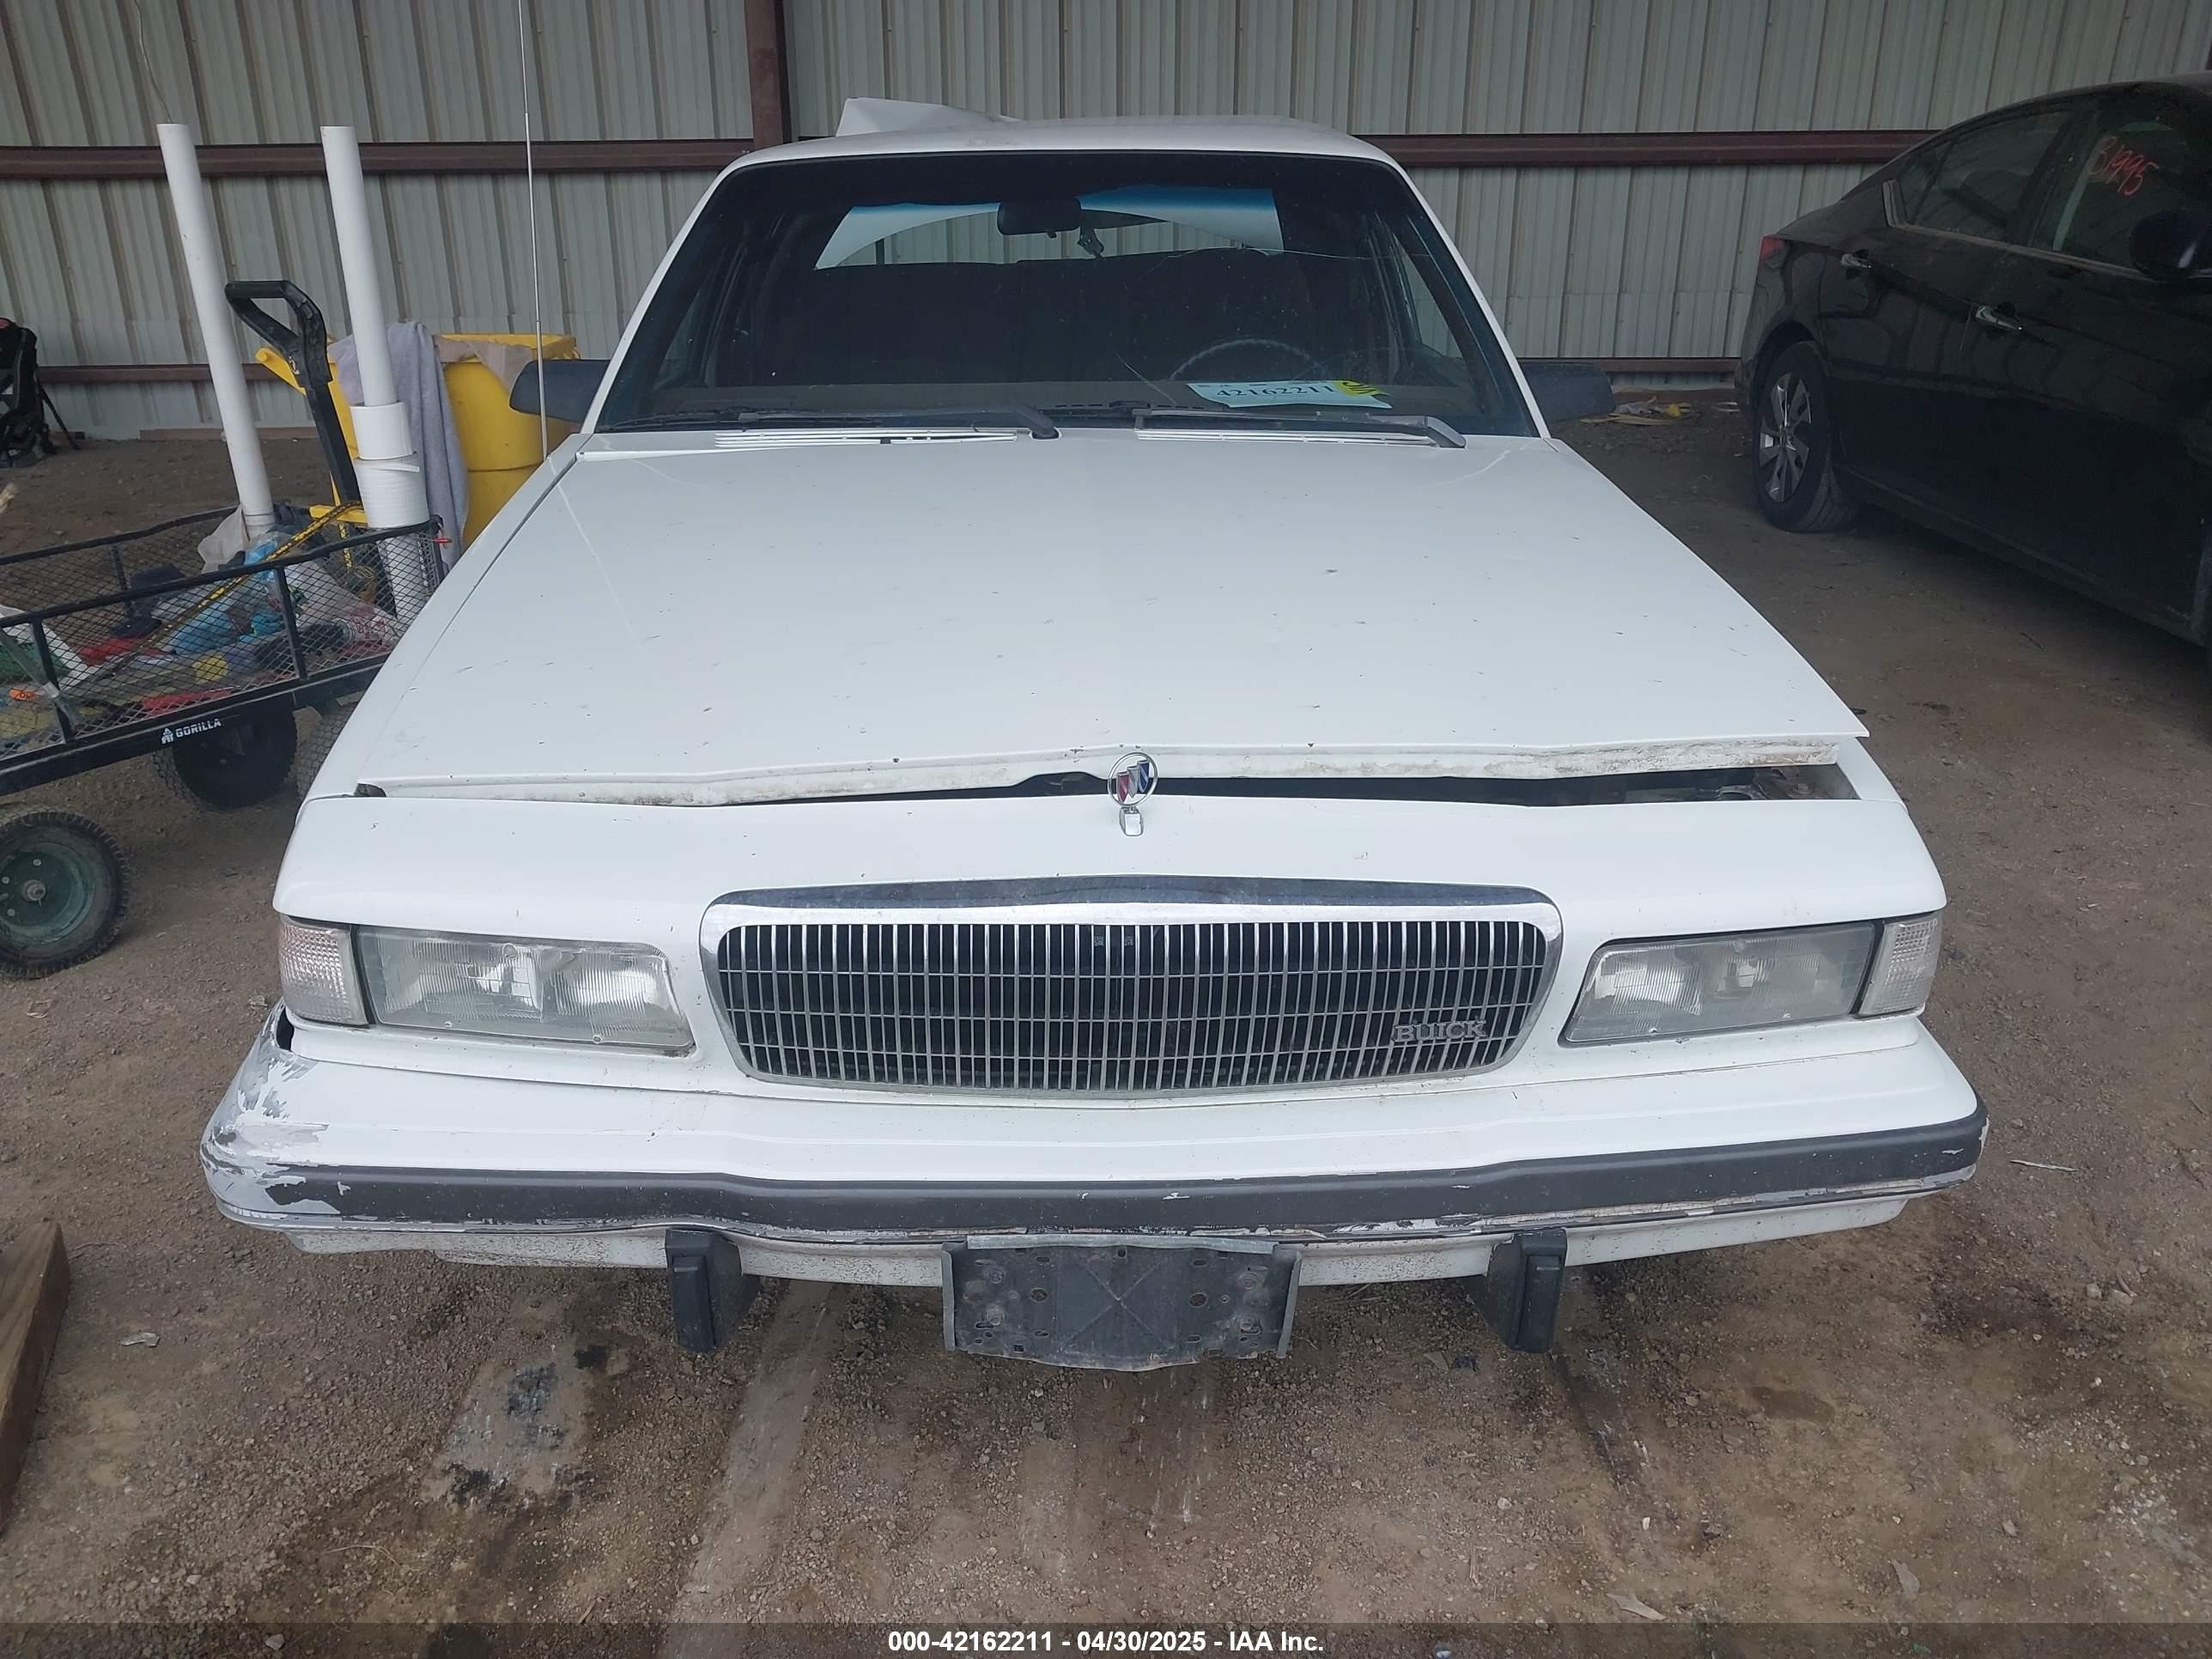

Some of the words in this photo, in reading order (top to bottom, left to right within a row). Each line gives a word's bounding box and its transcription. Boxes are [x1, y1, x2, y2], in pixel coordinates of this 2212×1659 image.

[1216, 385, 1335, 397] 42162211
[175, 718, 222, 738] GORILLA
[1393, 1020, 1486, 1042] BUICK
